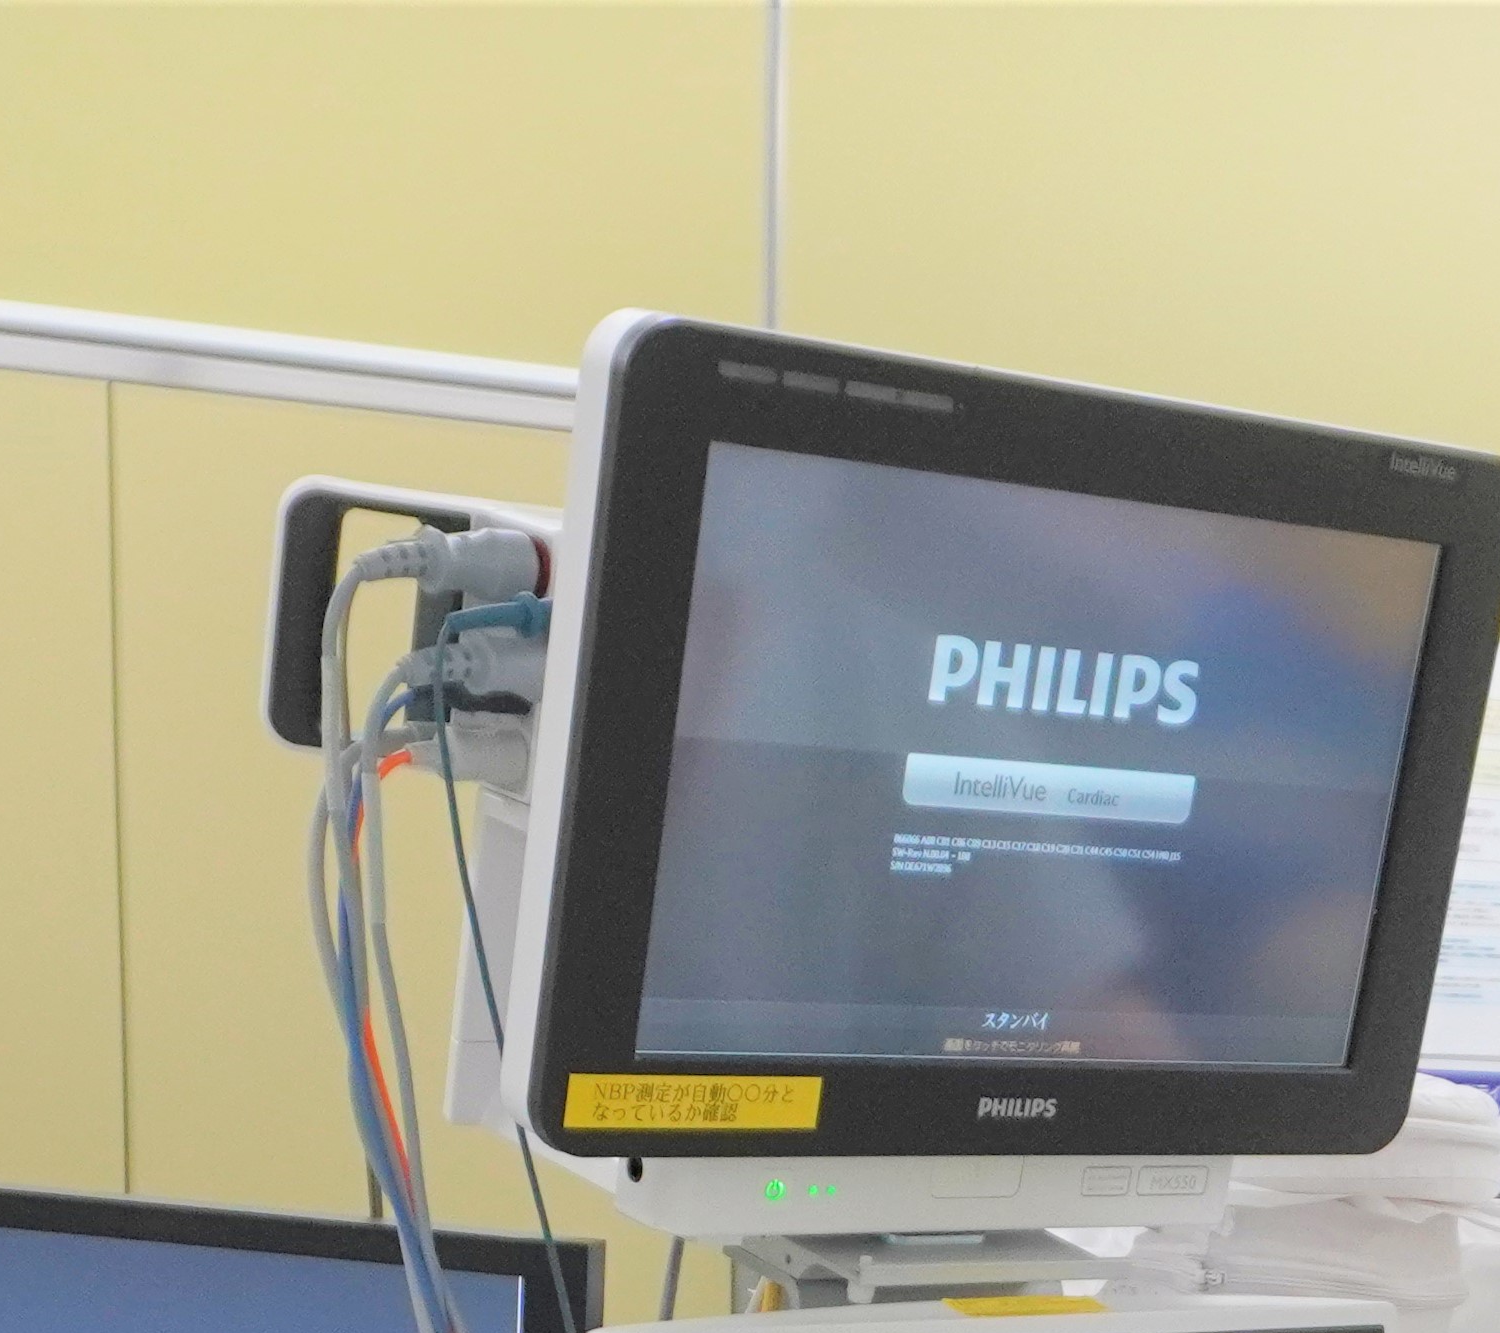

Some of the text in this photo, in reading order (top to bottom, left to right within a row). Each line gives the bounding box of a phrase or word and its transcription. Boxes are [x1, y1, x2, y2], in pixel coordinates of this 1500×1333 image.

[928, 635, 1200, 724] PHILIPS
[954, 771, 1120, 808] IntelliVue Cardiac
[982, 1012, 1050, 1031] スタンバイ
[592, 1103, 738, 1122] なっているか確認
[977, 1097, 1058, 1120] PHILIPS
